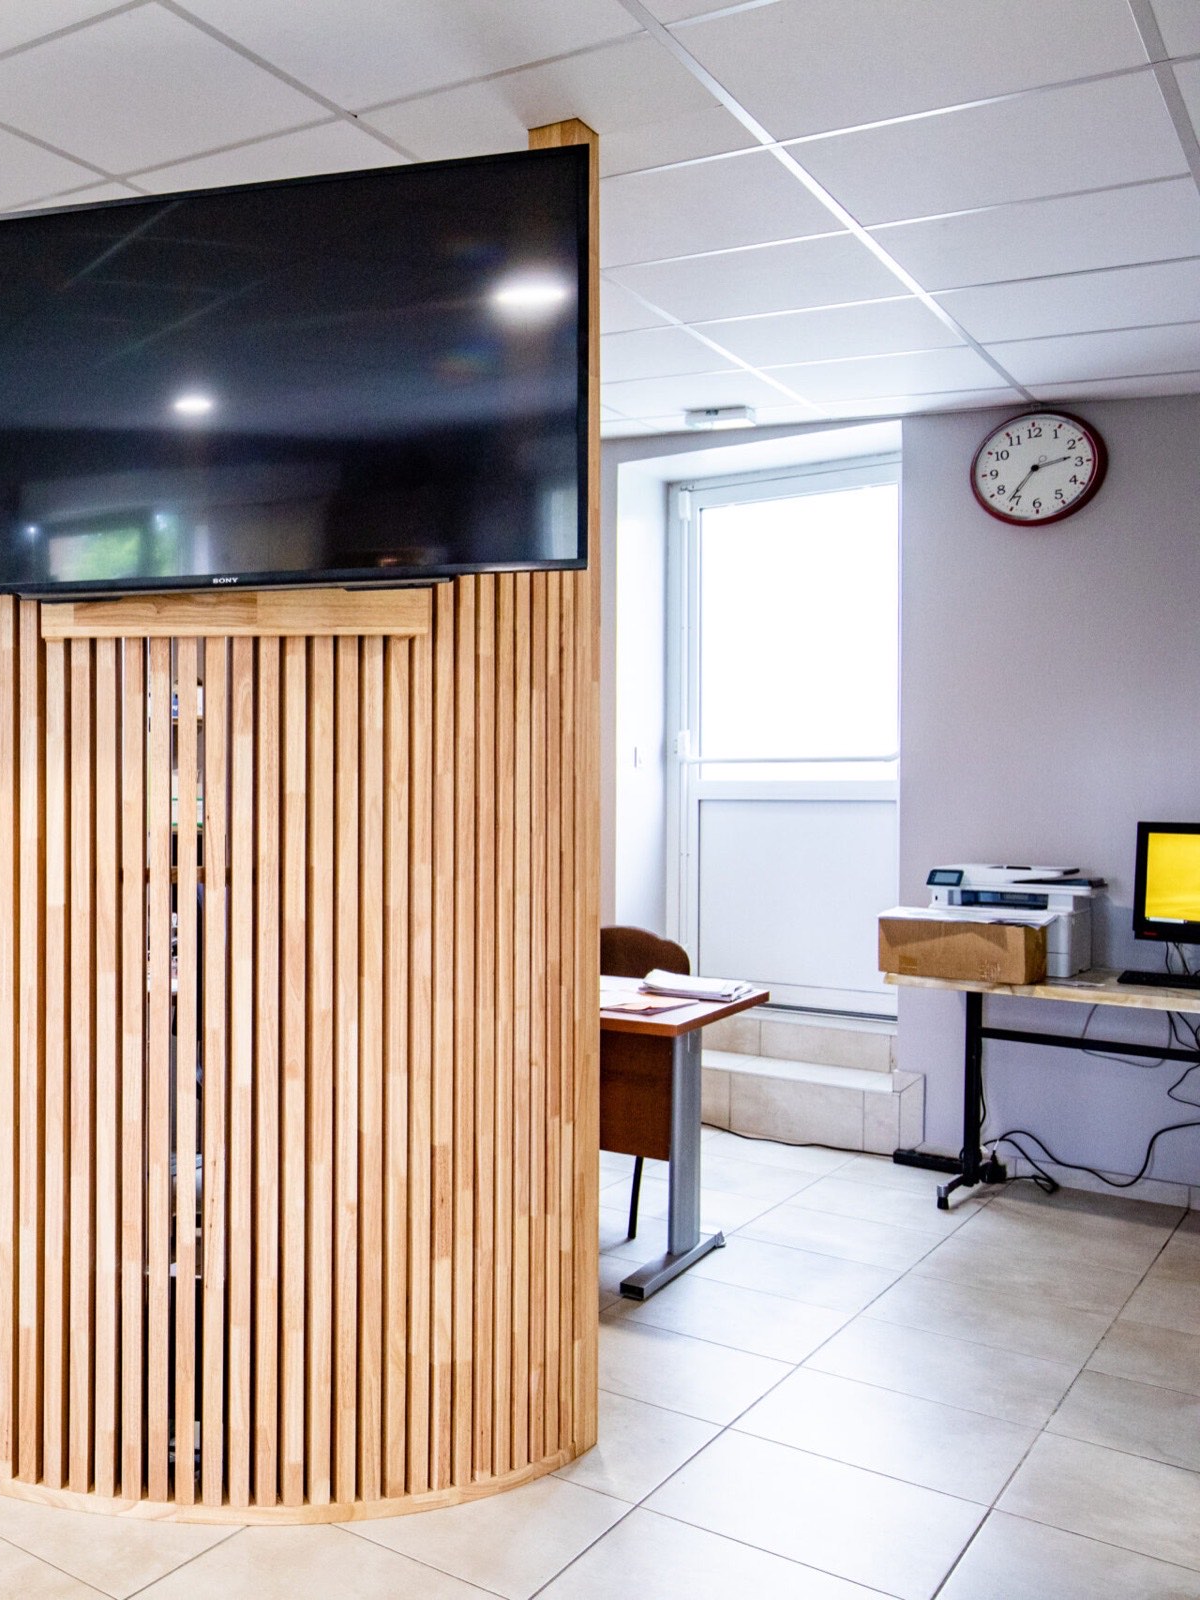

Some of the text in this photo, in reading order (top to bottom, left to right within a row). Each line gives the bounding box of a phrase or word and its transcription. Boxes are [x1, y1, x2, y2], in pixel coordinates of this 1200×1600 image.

[1027, 427, 1042, 439] 12
[1053, 430, 1059, 439] 1
[1008, 435, 1022, 447] 11
[1067, 439, 1076, 450] 2
[995, 450, 1009, 461] 10
[1075, 456, 1084, 467] 3
[990, 470, 999, 480] 9
[1069, 475, 1078, 485] 4
[997, 485, 1006, 495] 8
[1054, 489, 1063, 500] 5
[1013, 495, 1022, 506] 7
[1032, 498, 1042, 508] 6
